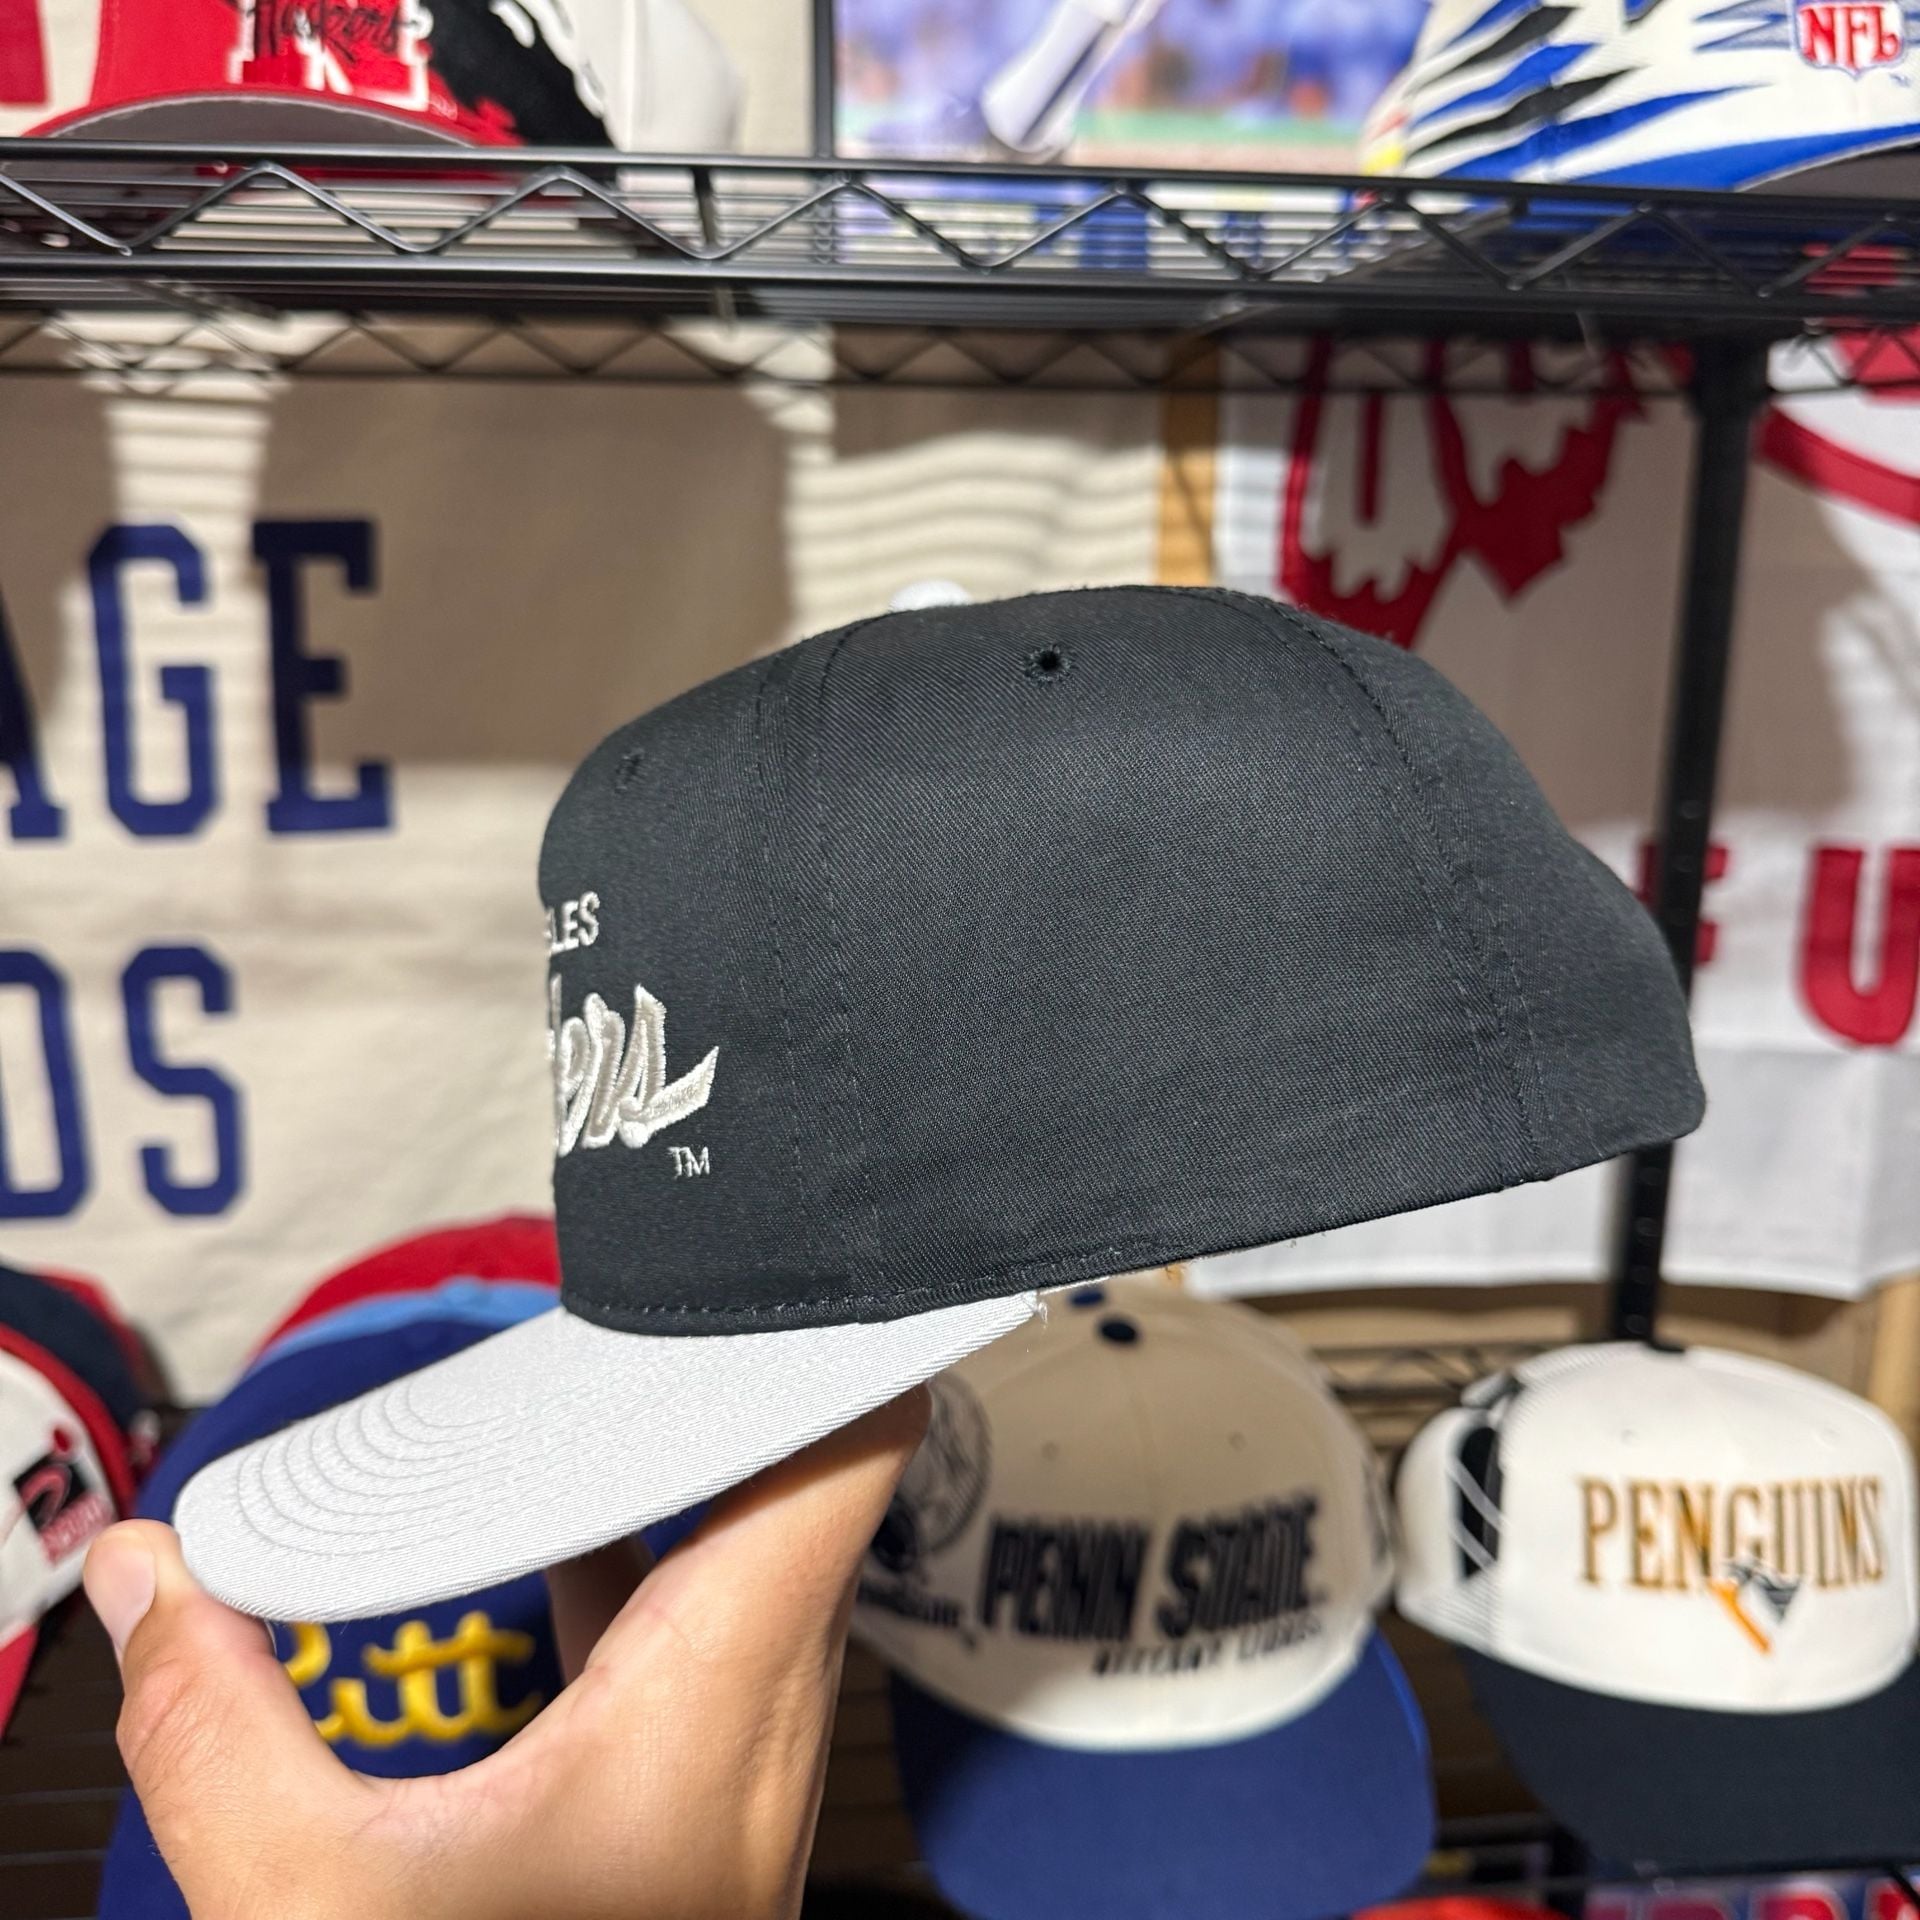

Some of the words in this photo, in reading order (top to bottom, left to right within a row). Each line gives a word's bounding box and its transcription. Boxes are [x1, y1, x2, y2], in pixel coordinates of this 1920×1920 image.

[1801, 6, 1899, 69] NFL
[545, 891, 600, 955] LES
[668, 1146, 710, 1178] TM
[1577, 1474, 1882, 1588] PENGUINS
[978, 1516, 1150, 1640] PENN
[1154, 1497, 1325, 1638] STATE
